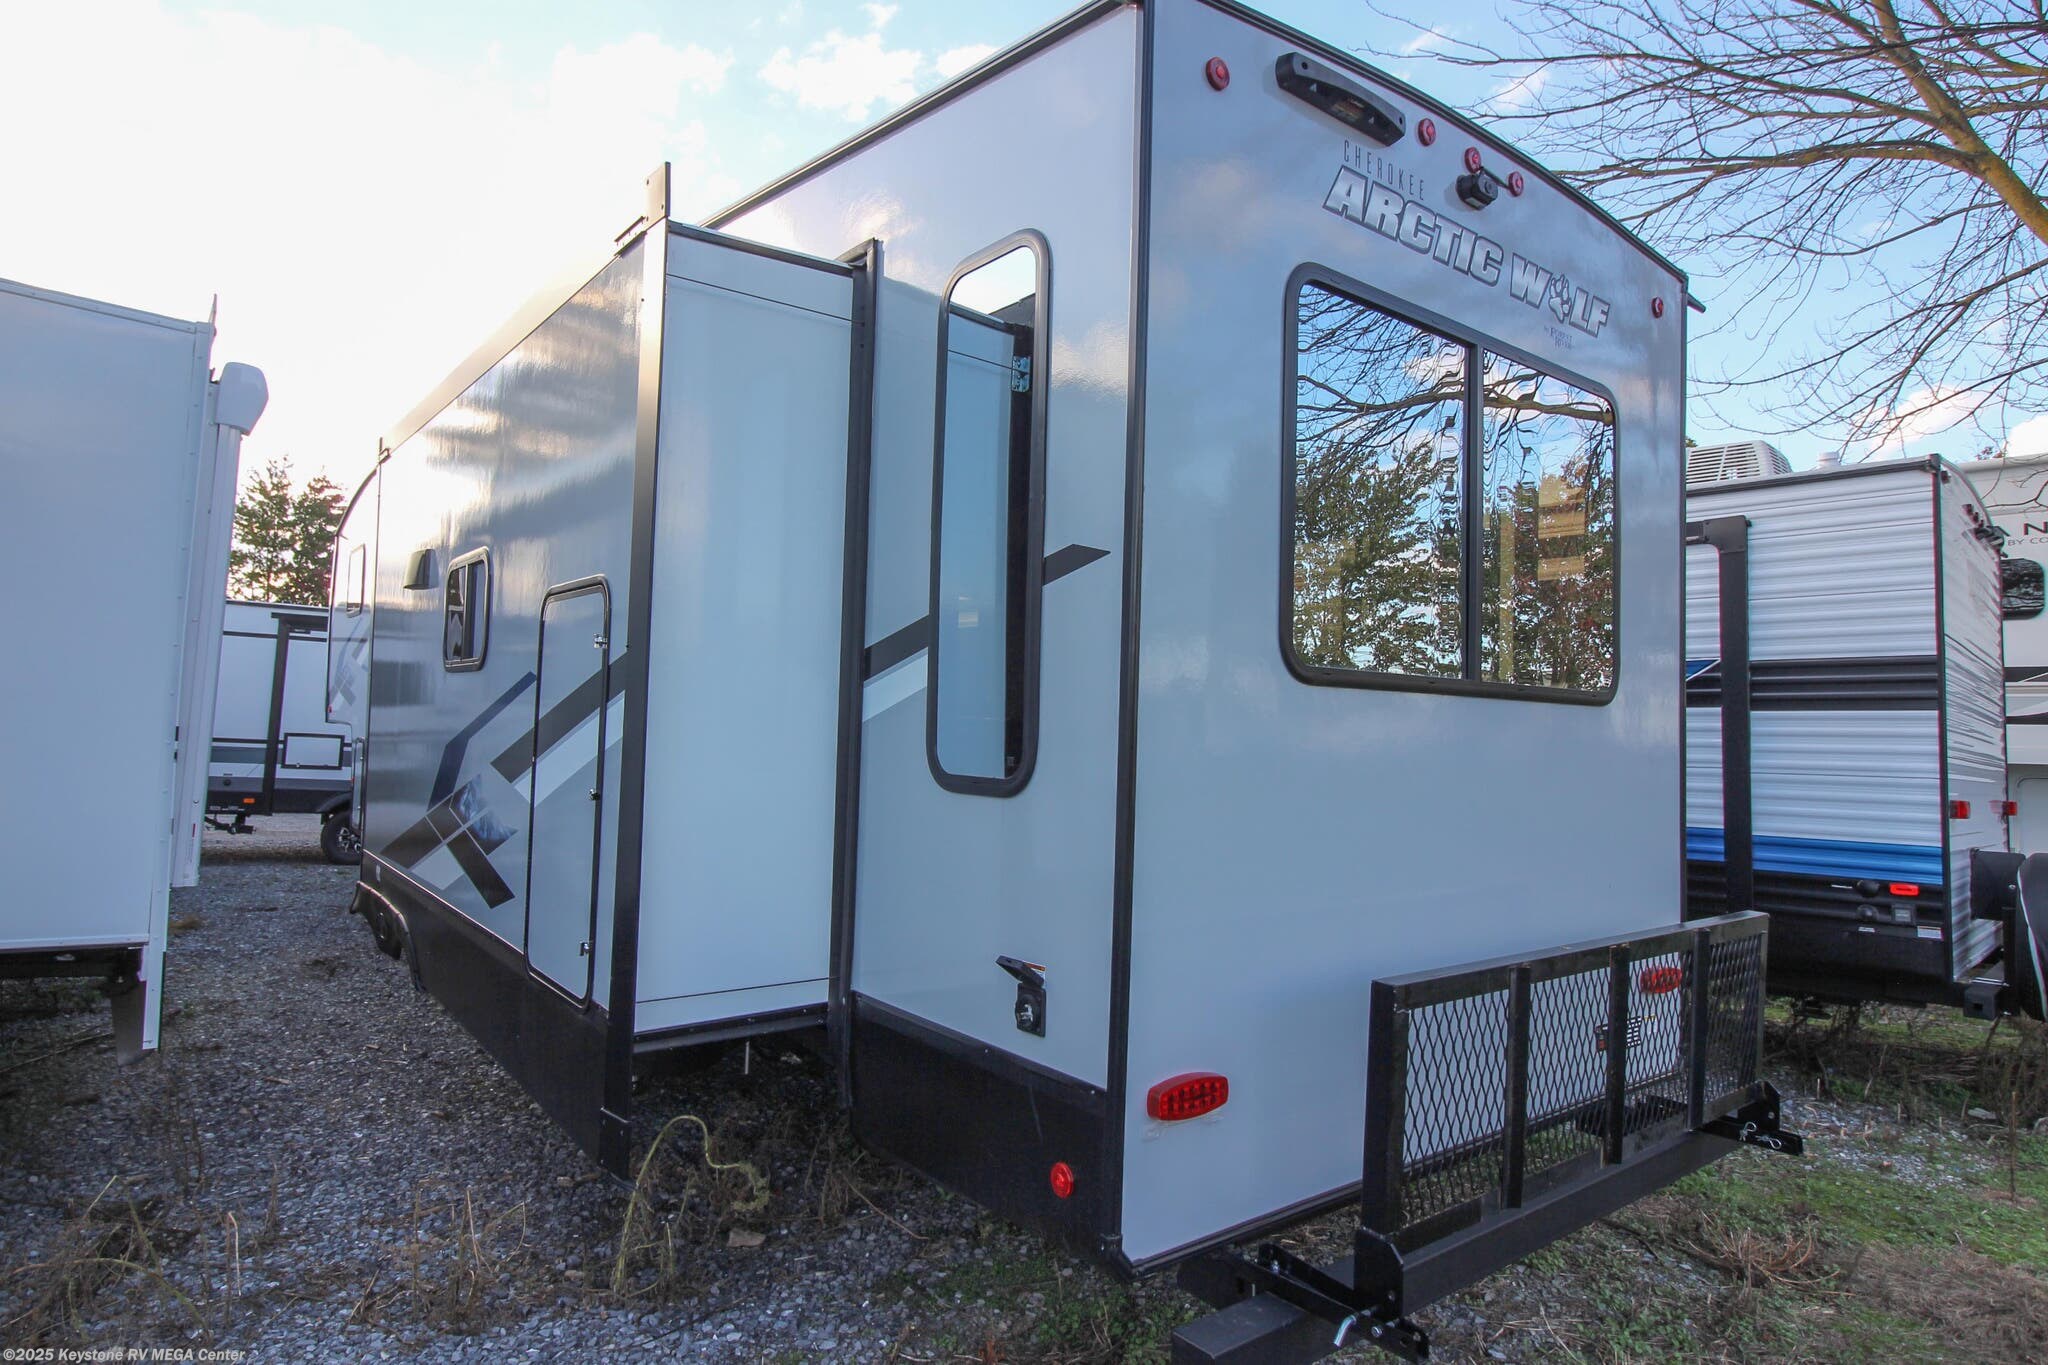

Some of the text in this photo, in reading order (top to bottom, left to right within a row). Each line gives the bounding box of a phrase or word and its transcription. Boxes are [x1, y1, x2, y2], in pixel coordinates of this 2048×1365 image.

[1343, 139, 1425, 201] CHEROKEE
[1322, 164, 1504, 287] ARCTIC
[2007, 538, 2025, 547] BY
